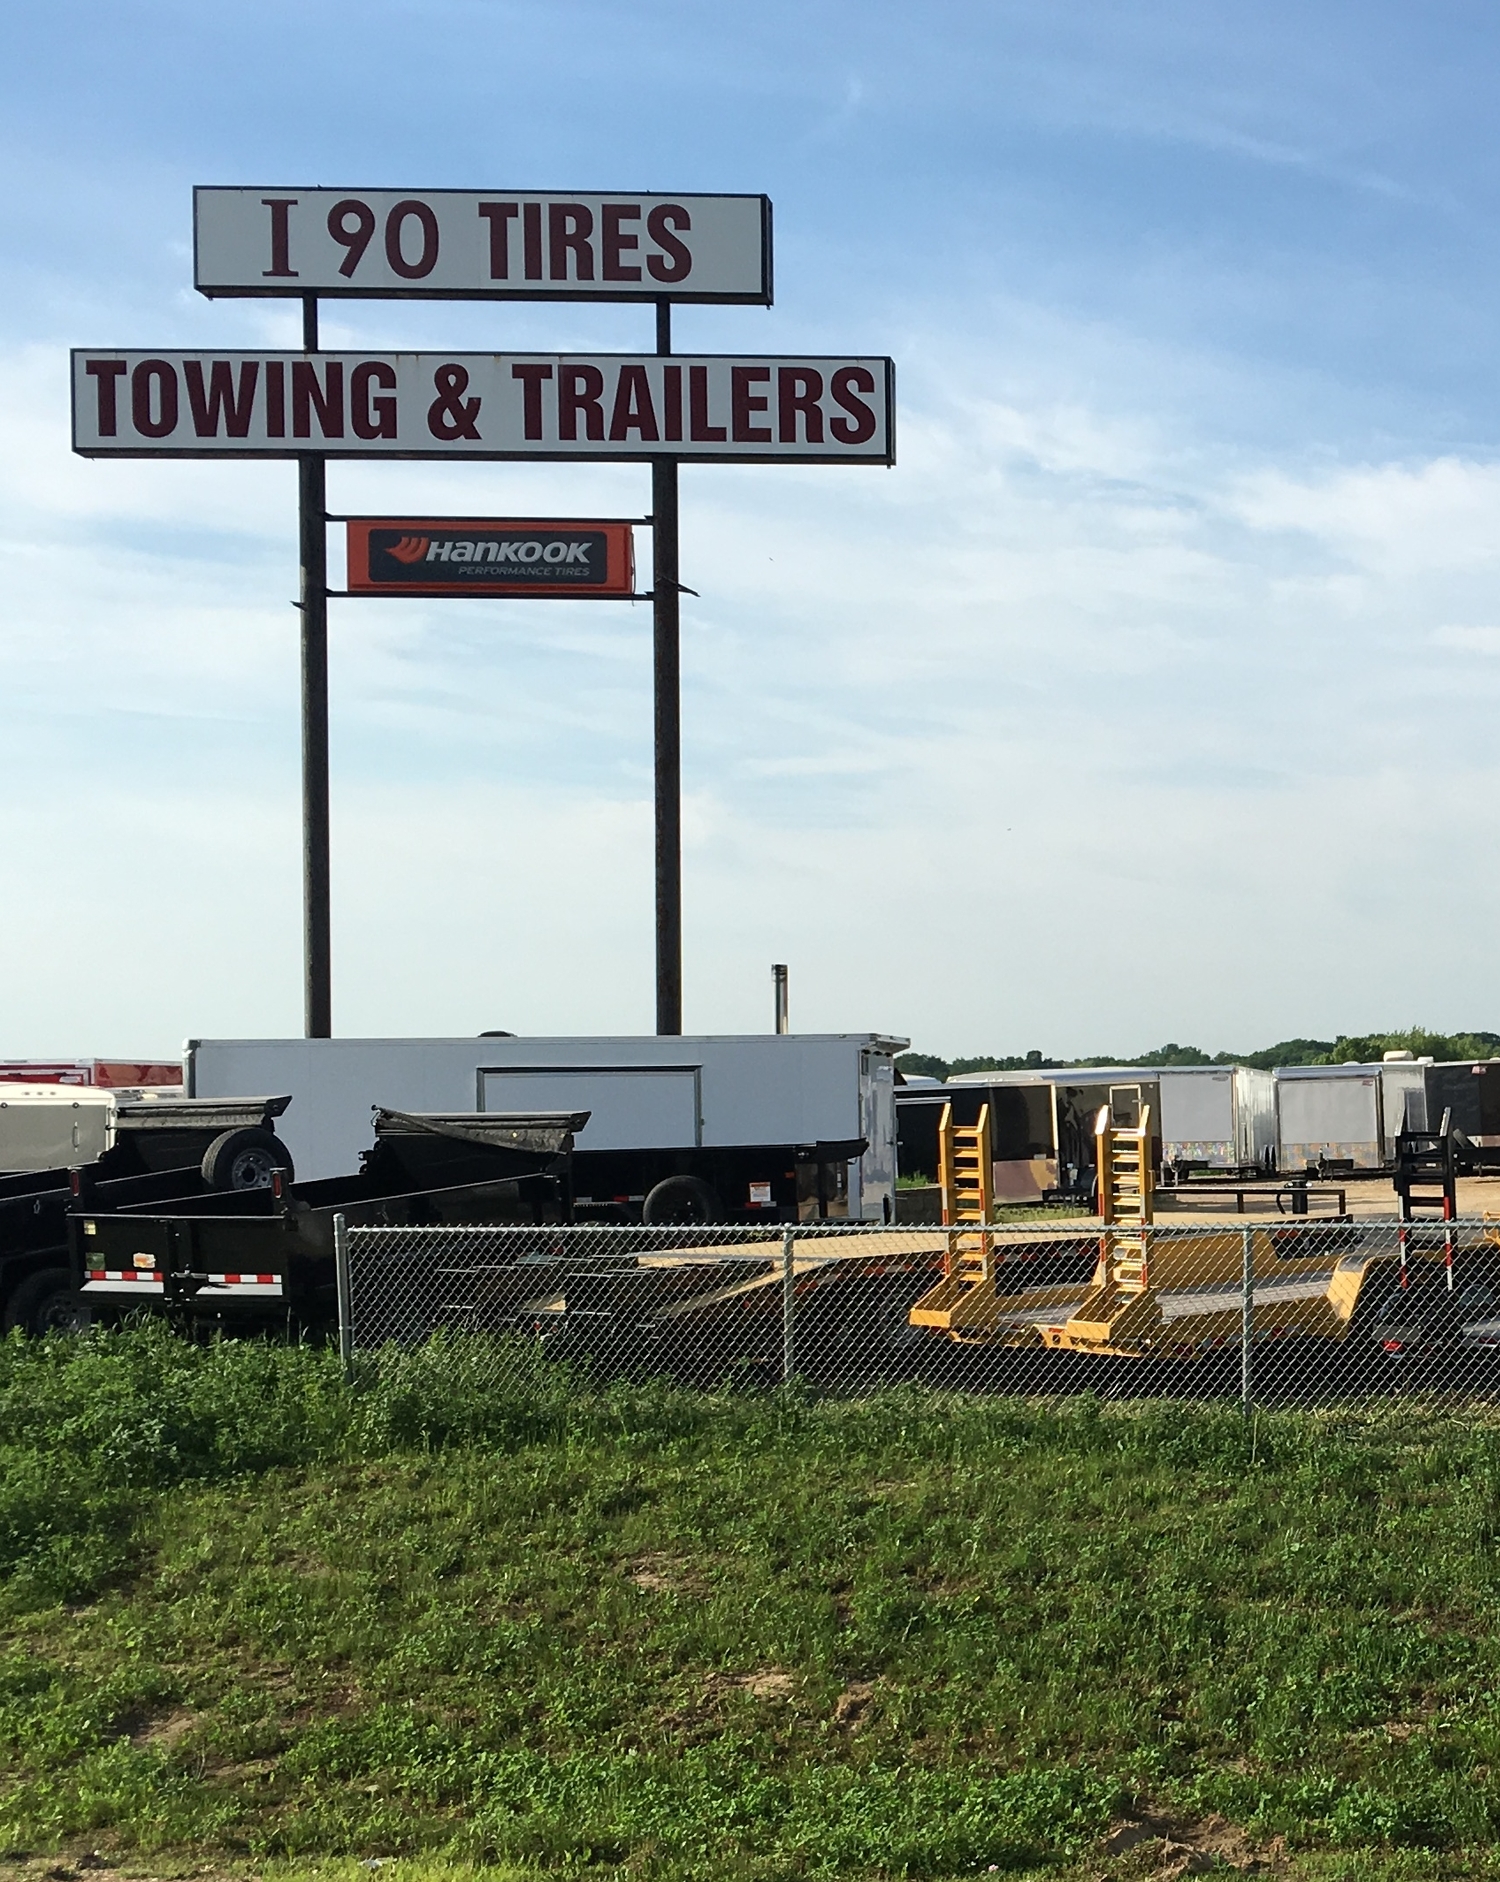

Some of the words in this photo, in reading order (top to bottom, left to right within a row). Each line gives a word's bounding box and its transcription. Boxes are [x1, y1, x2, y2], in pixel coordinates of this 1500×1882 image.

[261, 199, 300, 277] I
[326, 199, 440, 280] 90
[478, 202, 694, 284] TIRES
[85, 359, 398, 440] TOWING
[427, 363, 483, 442] &
[511, 362, 878, 445] TRAILERS
[458, 566, 552, 576] PERFORMANCE
[555, 567, 590, 576] TIRES
